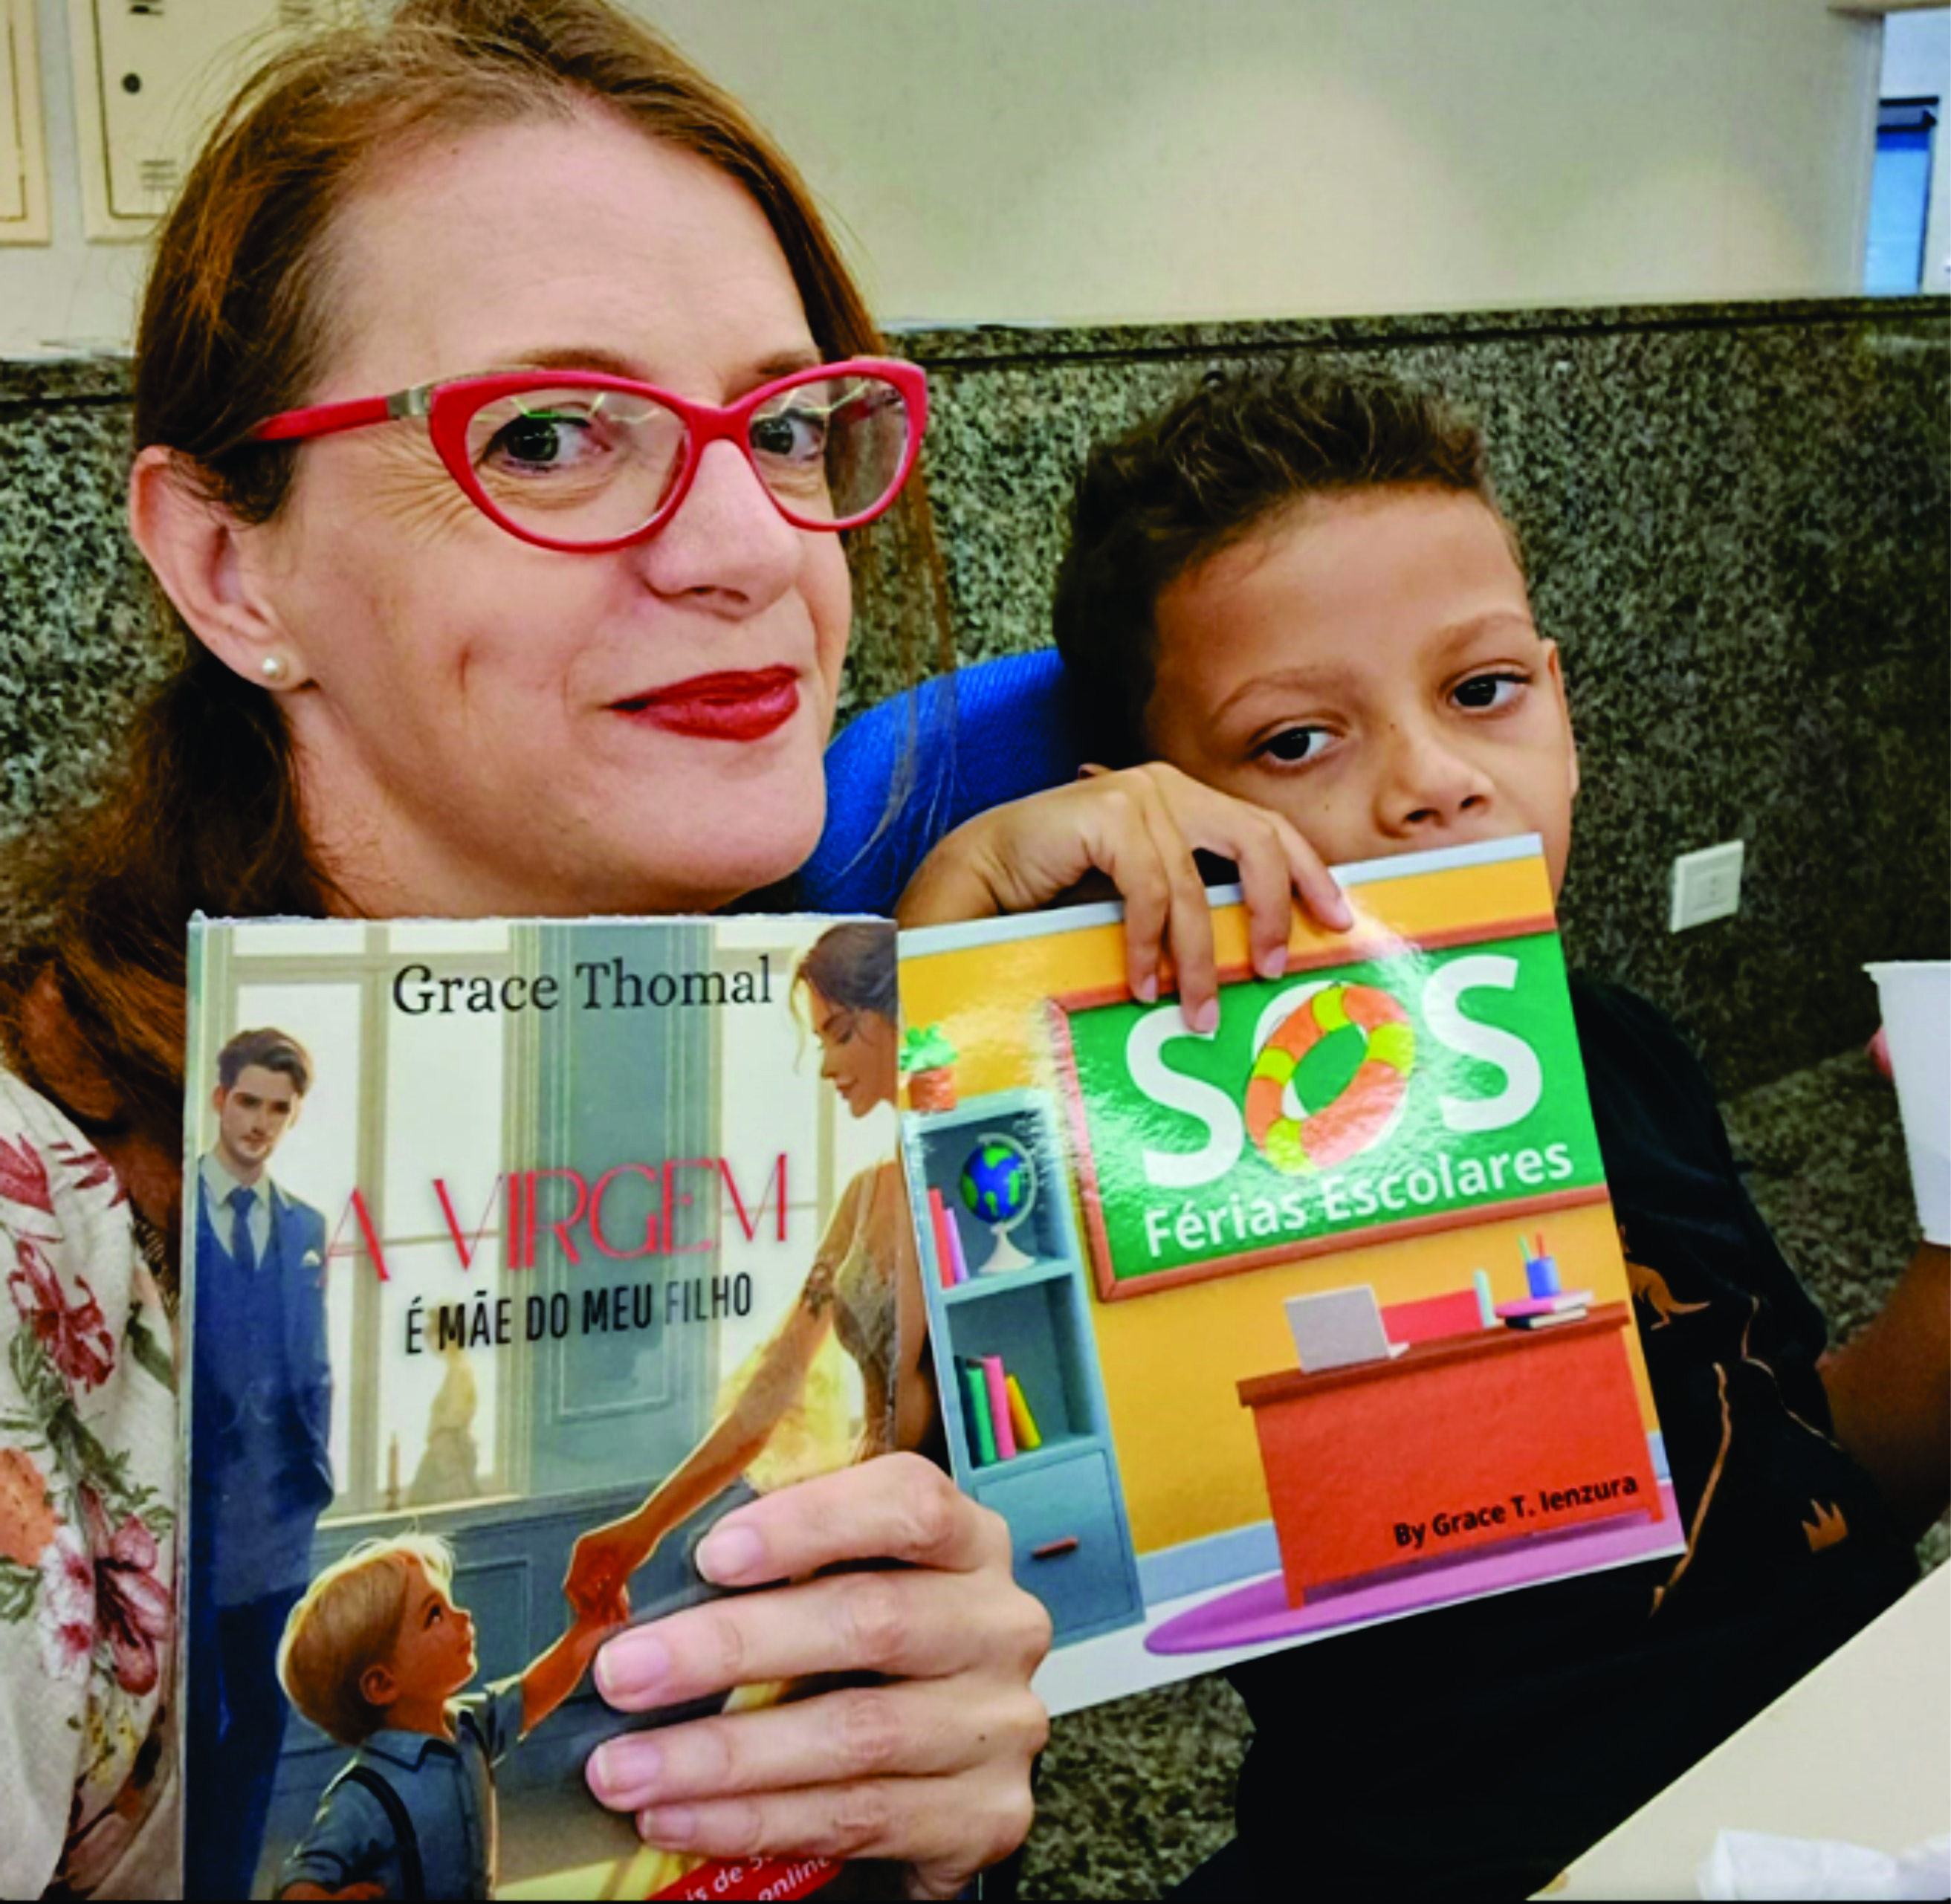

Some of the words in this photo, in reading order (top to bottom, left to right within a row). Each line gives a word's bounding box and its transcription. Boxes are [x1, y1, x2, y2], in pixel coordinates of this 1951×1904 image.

[392, 964, 559, 1015] Grace
[575, 955, 773, 1010] Thomal
[1125, 953, 1543, 1187] SOS
[325, 1188, 391, 1283] A
[433, 1152, 789, 1271] VIRGEM
[1144, 1192, 1308, 1257] Férias
[1320, 1142, 1573, 1222] Escolares
[404, 1297, 424, 1355] É
[438, 1290, 513, 1350] MÃE
[525, 1293, 569, 1339] DO
[581, 1285, 653, 1333] MEU
[664, 1272, 754, 1324] FILHO
[1394, 1521, 1426, 1550] By
[1432, 1503, 1506, 1537] Grace
[1510, 1495, 1536, 1518] T.
[714, 1865, 744, 1893] de
